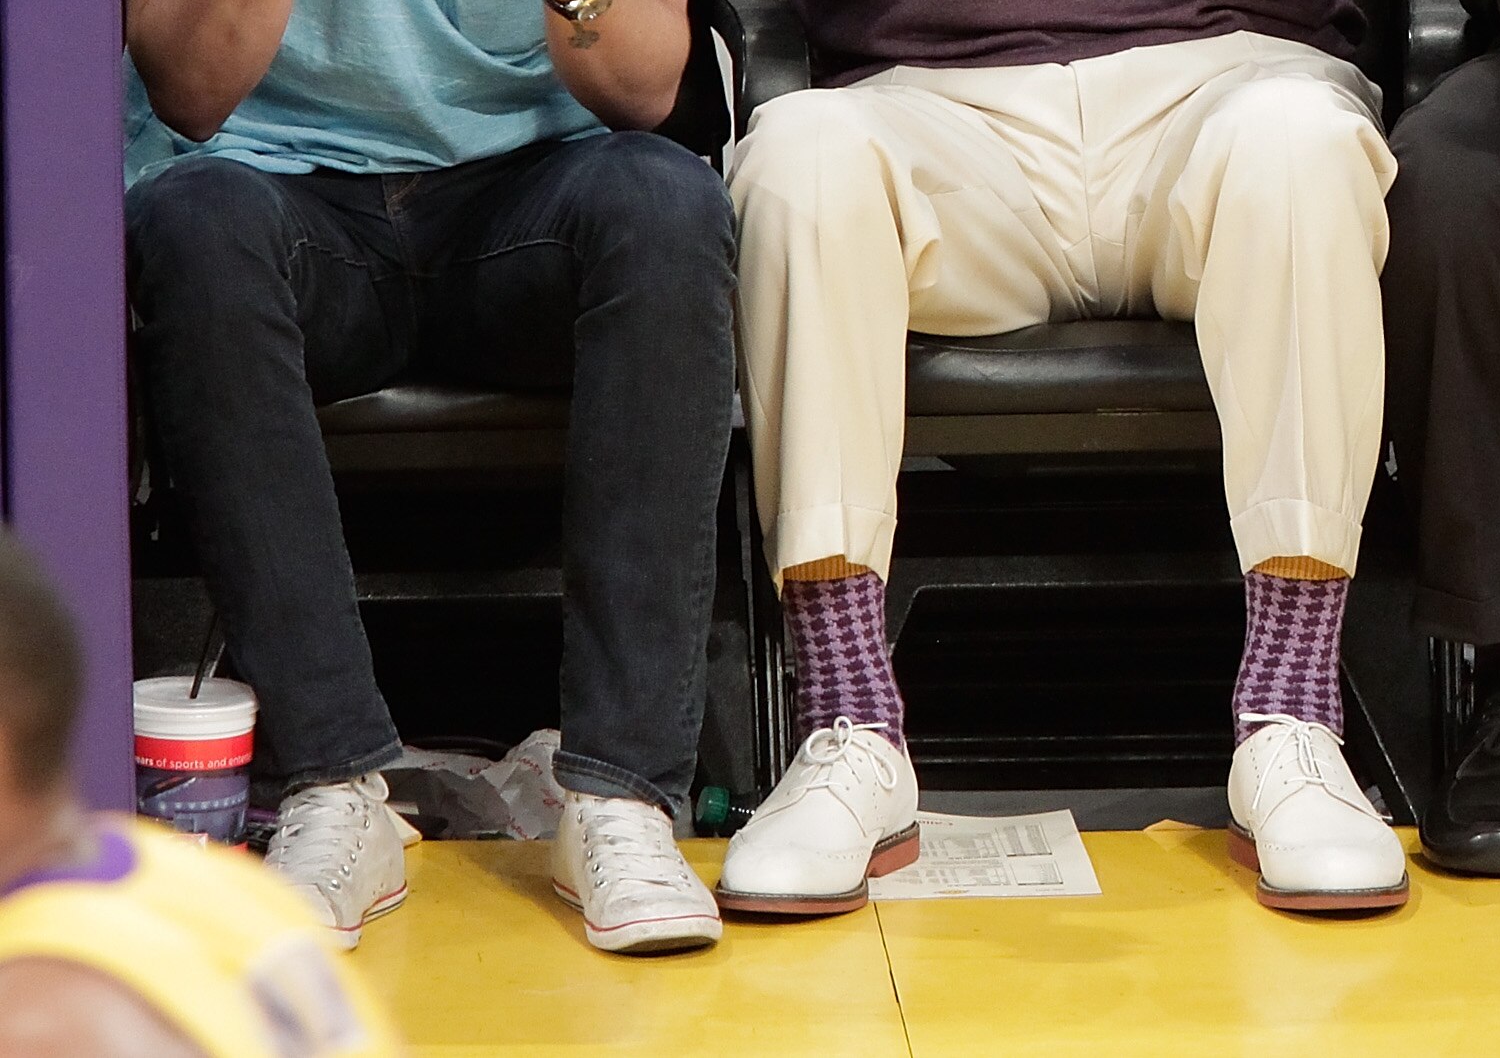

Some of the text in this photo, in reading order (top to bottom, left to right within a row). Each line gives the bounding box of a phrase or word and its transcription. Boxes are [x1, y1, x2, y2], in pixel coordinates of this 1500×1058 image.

[155, 757, 167, 768] of
[169, 759, 204, 770] sports
[207, 756, 227, 769] and
